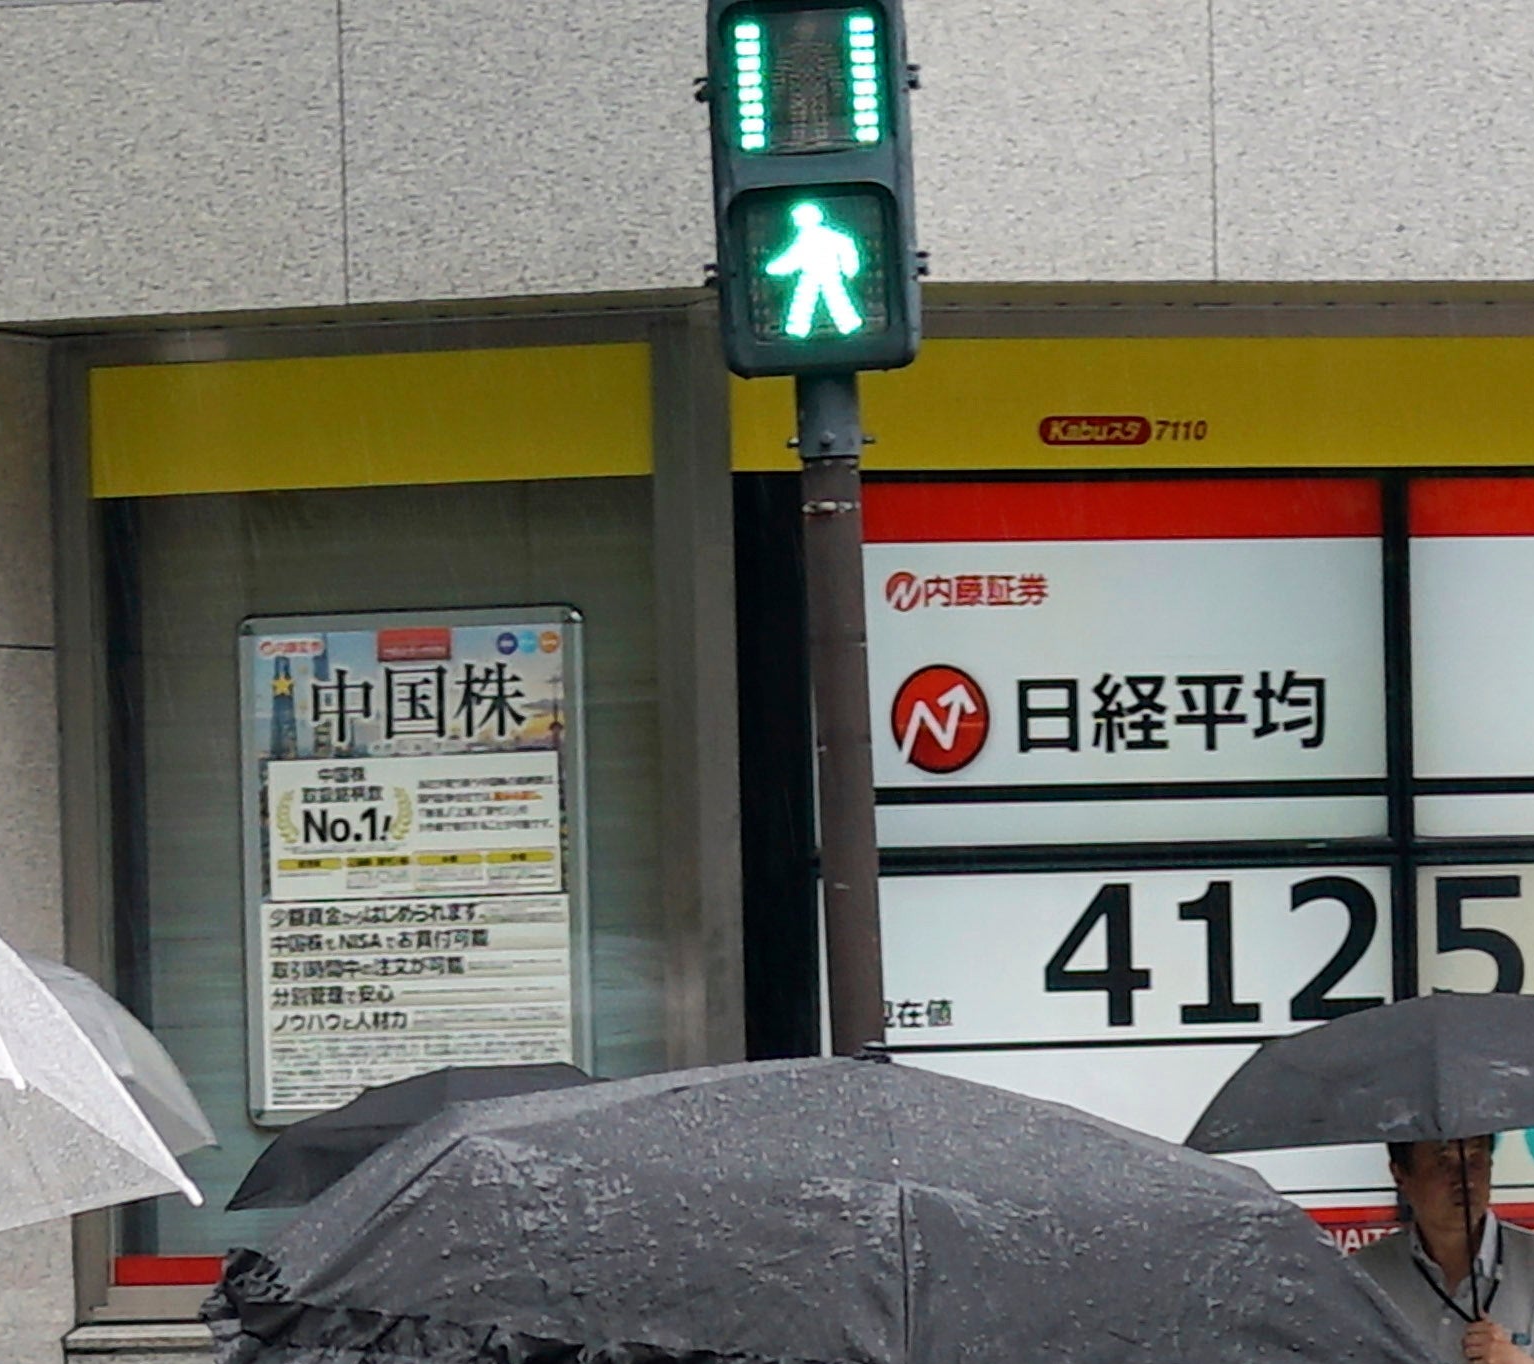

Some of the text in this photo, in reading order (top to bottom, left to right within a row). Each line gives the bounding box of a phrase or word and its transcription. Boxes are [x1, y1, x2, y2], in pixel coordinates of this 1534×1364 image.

[1154, 419, 1208, 442] 7110
[923, 573, 1050, 607] 内藤証券
[311, 661, 526, 743] 中国株
[1016, 670, 1328, 754] 日経平均
[302, 807, 393, 844] No.1!
